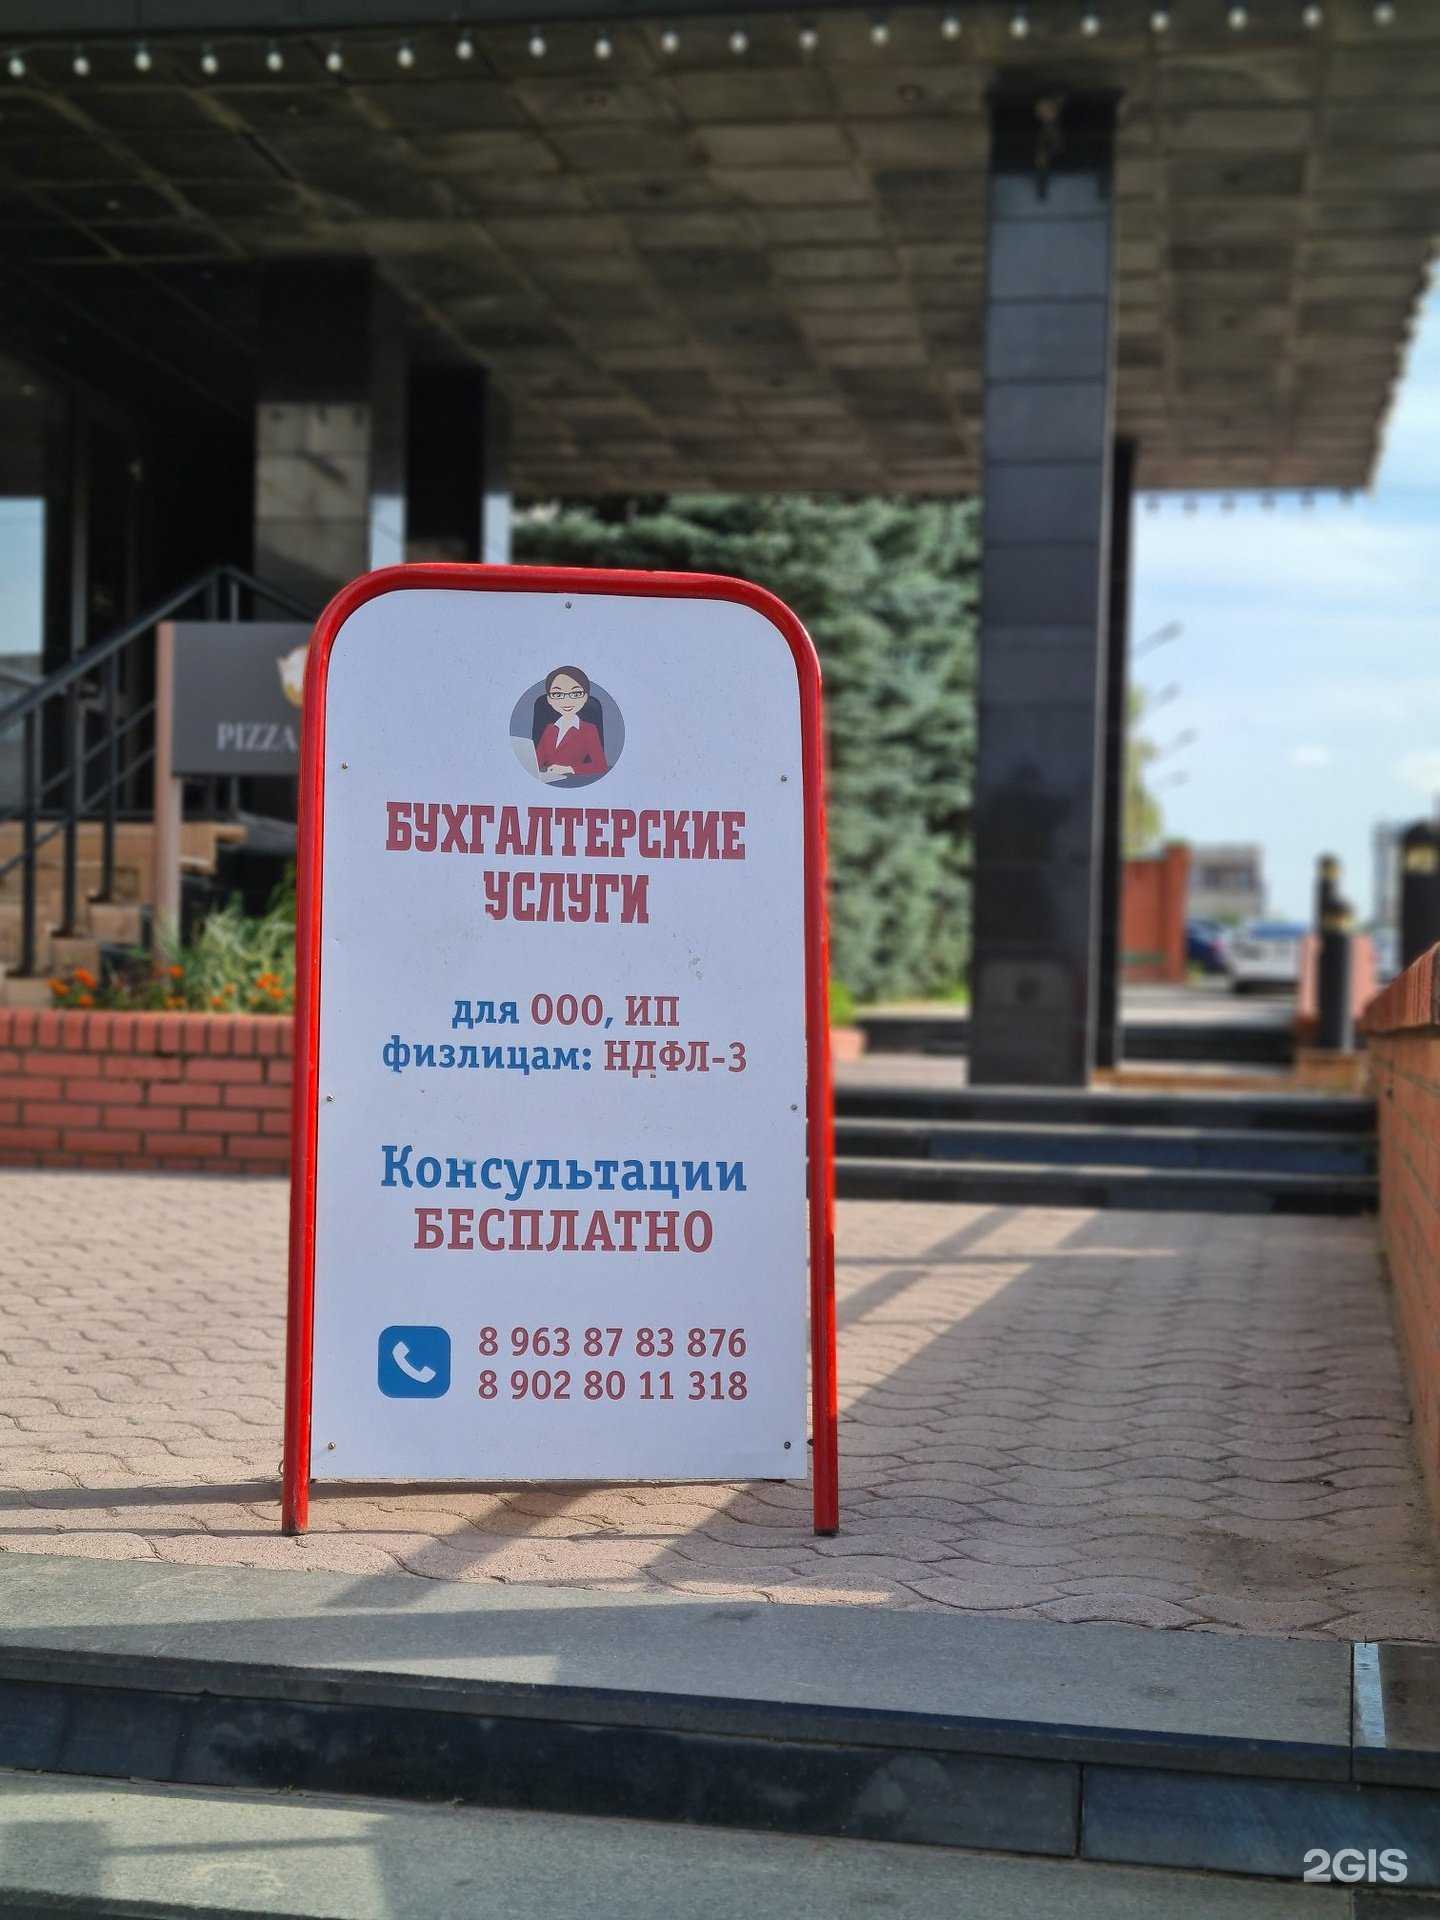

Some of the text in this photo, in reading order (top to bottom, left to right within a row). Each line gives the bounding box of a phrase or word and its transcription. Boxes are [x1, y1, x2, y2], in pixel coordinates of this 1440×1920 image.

[385, 801, 746, 860] БУХГАЛТЕРСКИЕ
[483, 870, 650, 924] УСЛУГИ
[451, 993, 680, 1029] для ООО, ИП
[382, 1034, 747, 1079] физлицам: НДФЛ-3
[380, 1144, 747, 1201] Консультации
[413, 1207, 713, 1253] БЕСПЛАТНО
[478, 1326, 747, 1358] 8 963 87 83 876
[478, 1369, 748, 1401] 8 902 80 11 318
